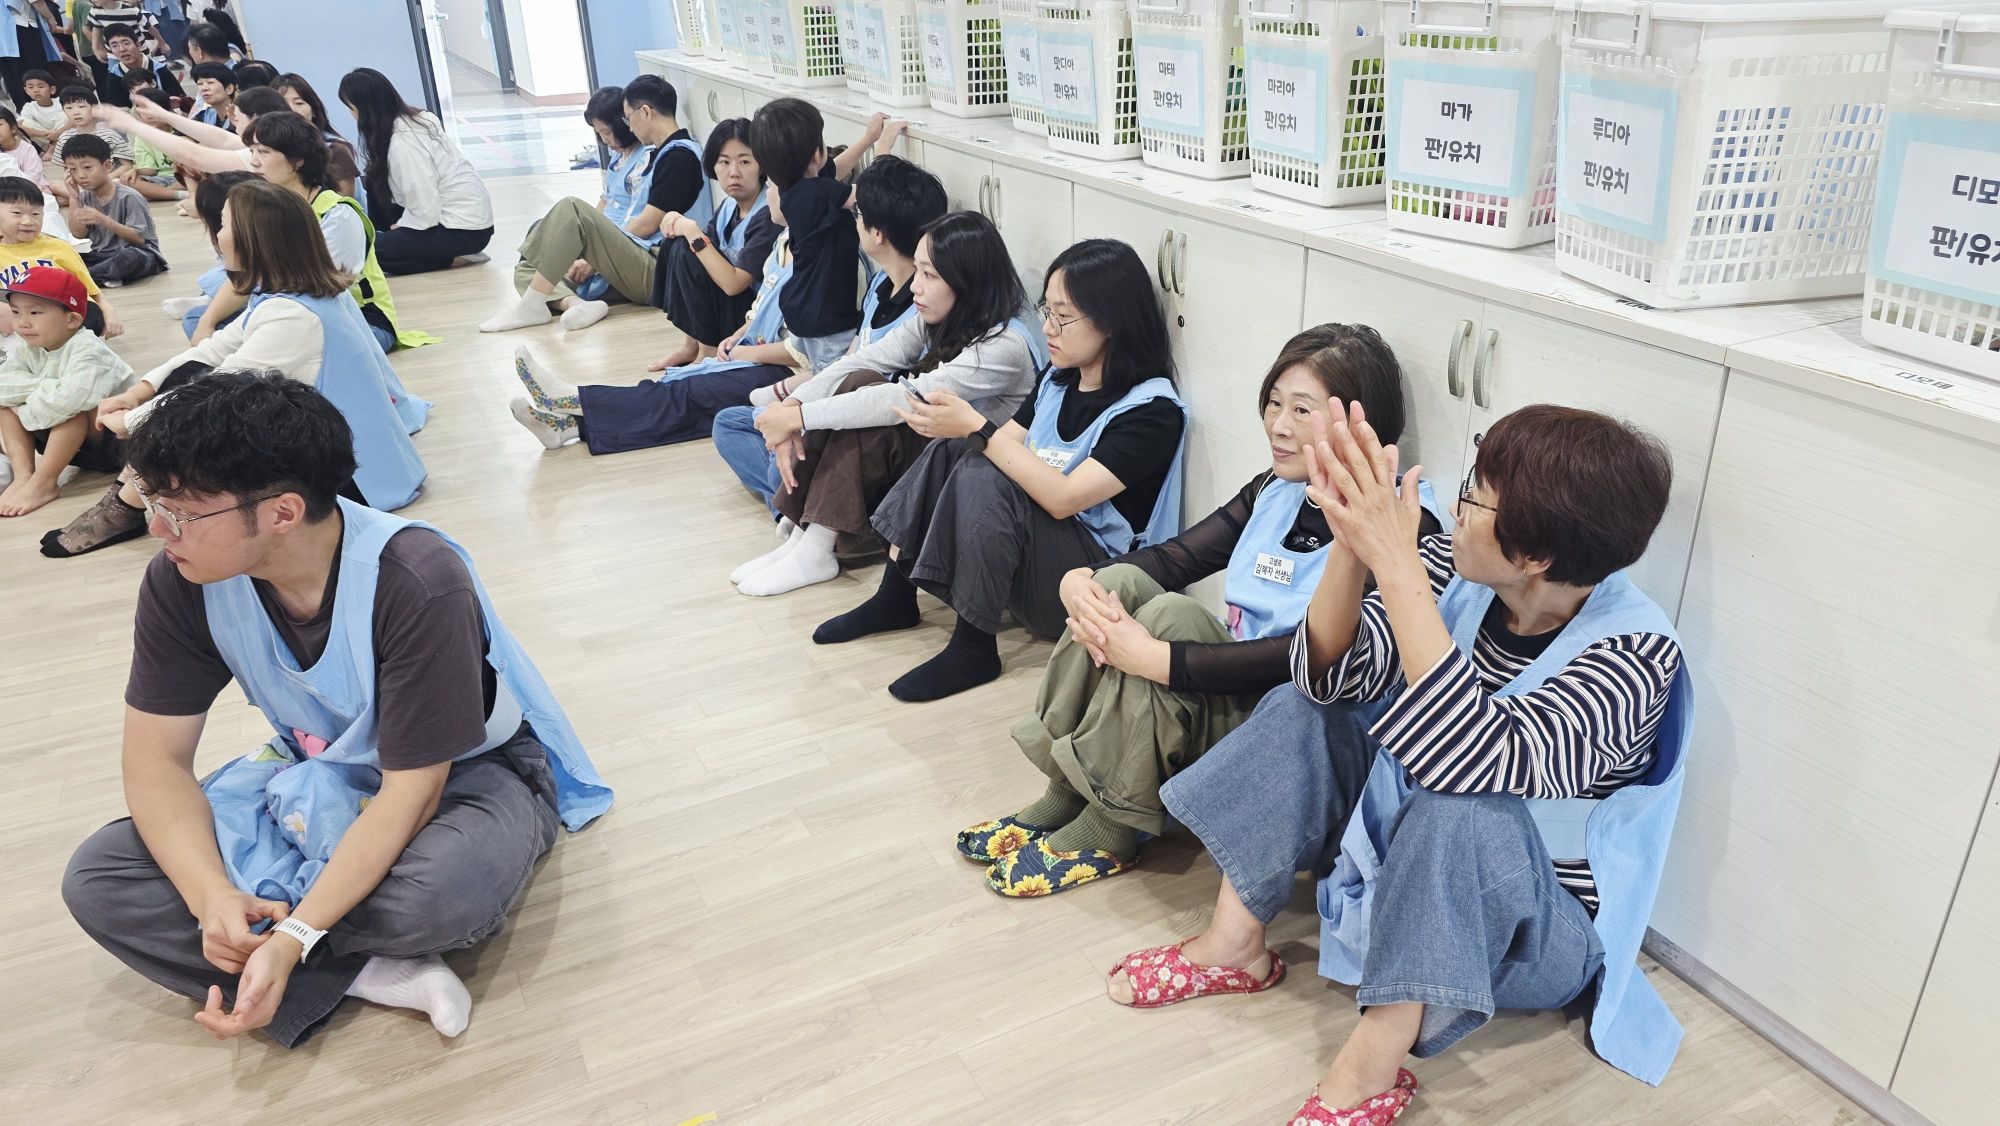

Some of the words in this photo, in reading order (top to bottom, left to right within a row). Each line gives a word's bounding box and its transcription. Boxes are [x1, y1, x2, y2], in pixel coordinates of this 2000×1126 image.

[1158, 61, 1176, 77] 마태
[1267, 78, 1296, 98] 마리아
[1152, 89, 1183, 110] 판/유치
[1264, 110, 1297, 133] 판/유치
[1440, 101, 1473, 122] 마가
[1592, 117, 1631, 146] 루디아
[1424, 137, 1482, 164] 판/유치
[1583, 160, 1630, 195] 판/유치
[0, 258, 55, 288] YA
[1274, 568, 1293, 583] 선생님
